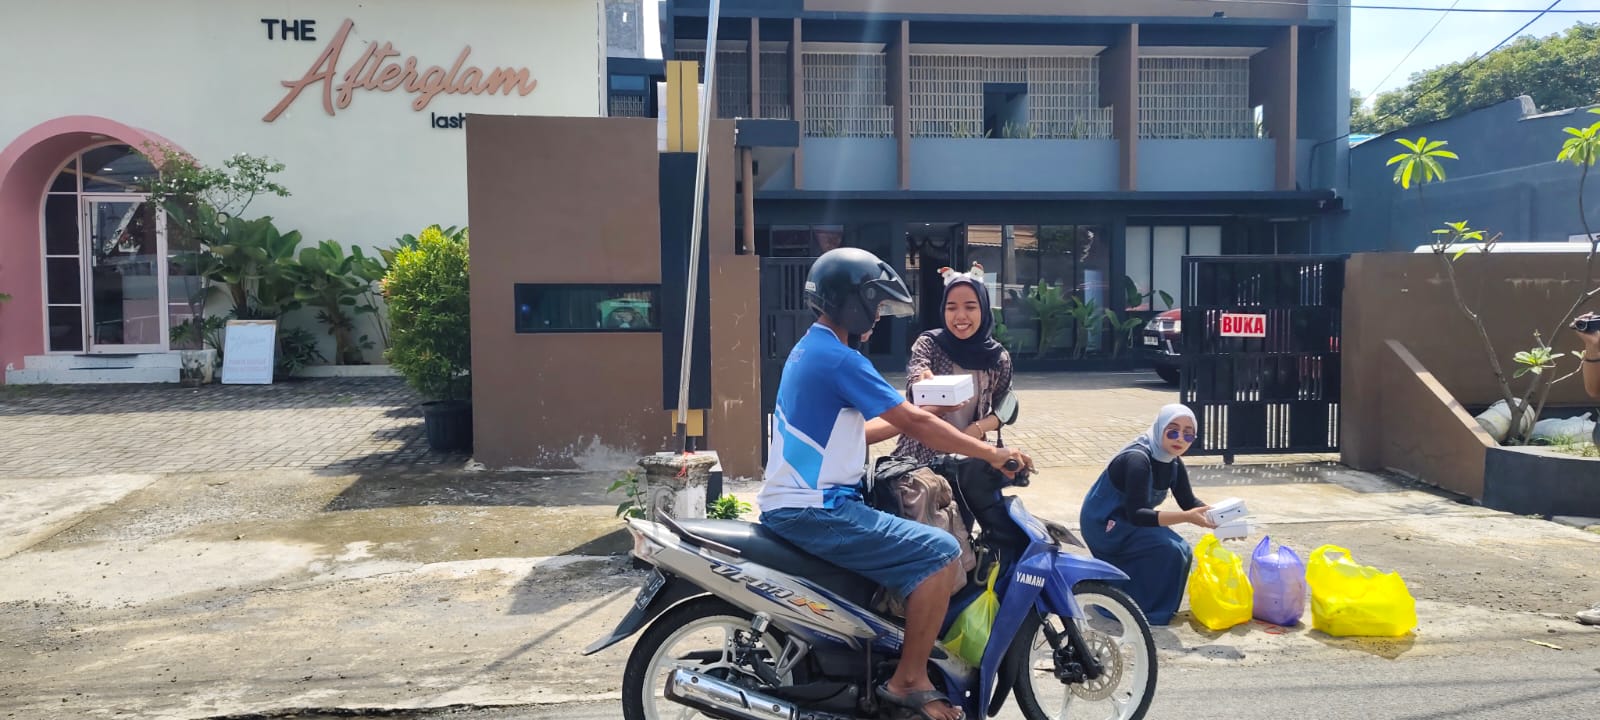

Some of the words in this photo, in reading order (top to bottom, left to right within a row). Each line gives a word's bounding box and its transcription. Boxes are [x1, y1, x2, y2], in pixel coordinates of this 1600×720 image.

[261, 18, 316, 41] THE
[262, 18, 537, 122] Afterglam
[1222, 316, 1264, 333] BUKA
[1016, 571, 1045, 588] YAMAHA
